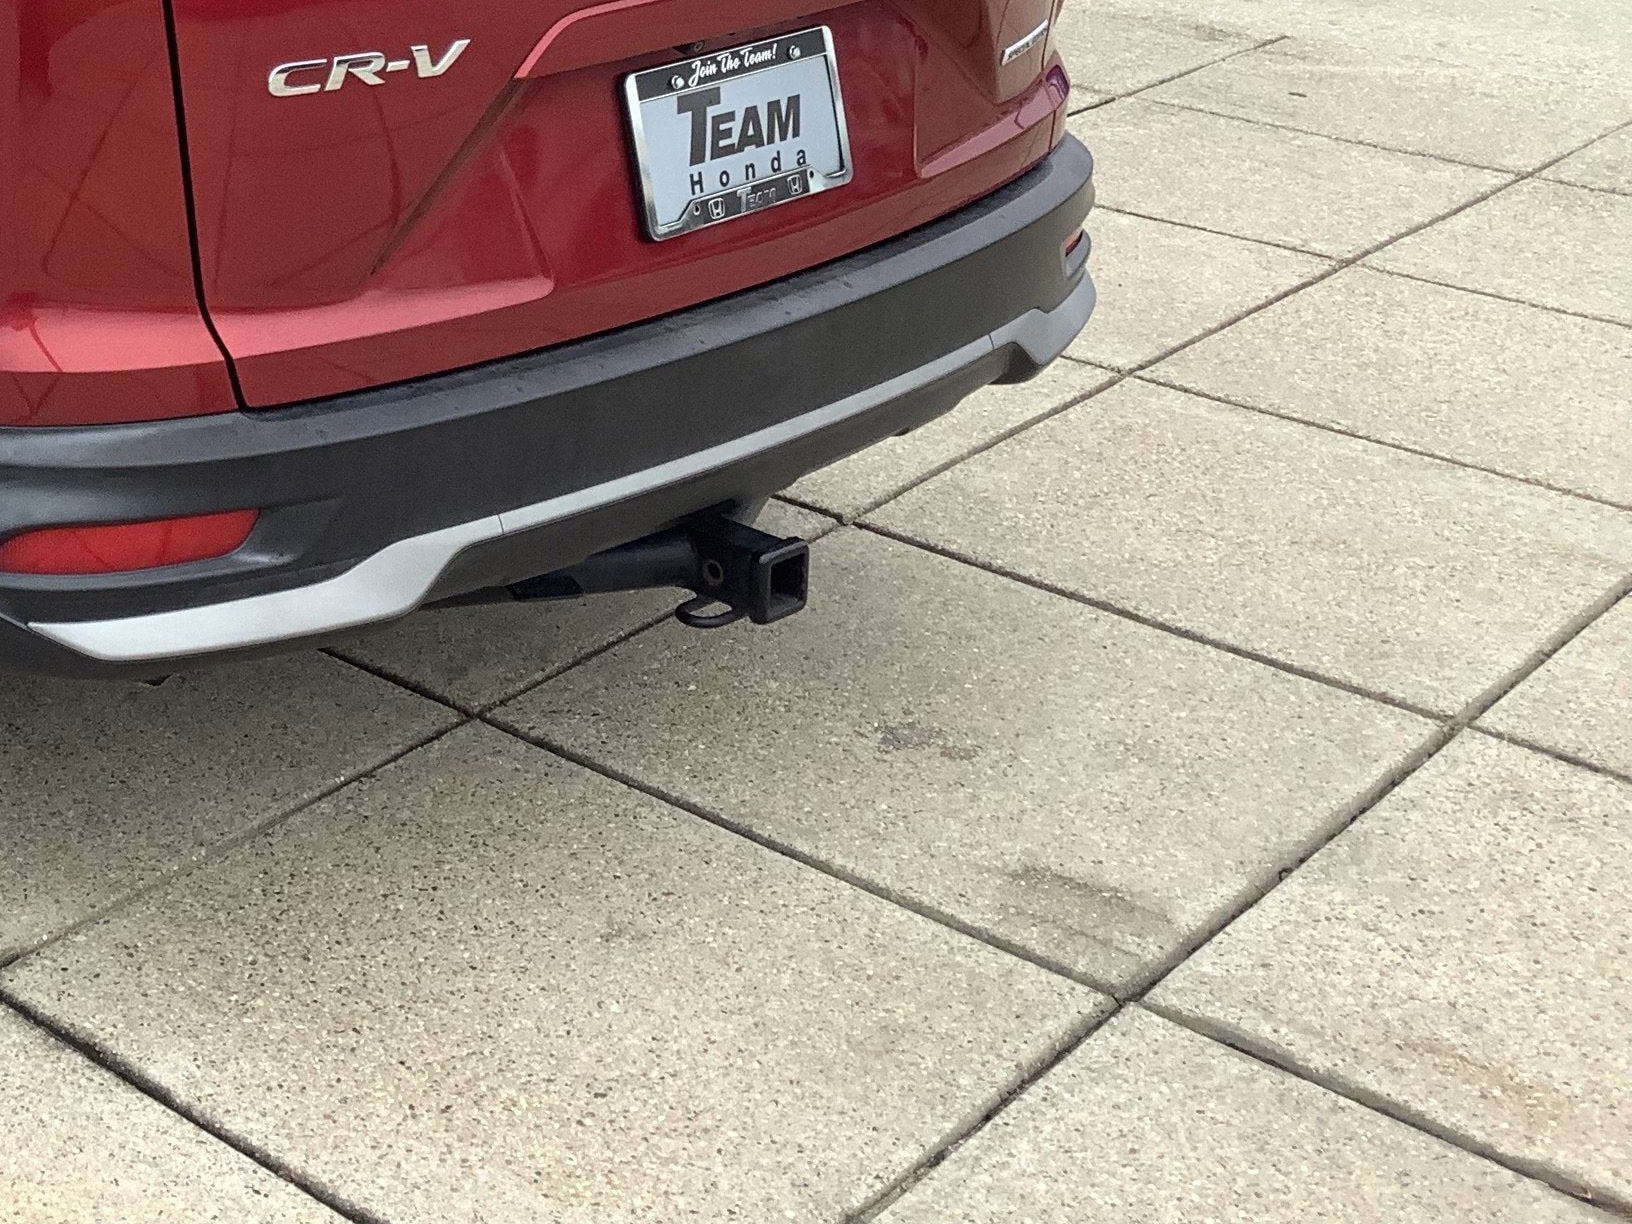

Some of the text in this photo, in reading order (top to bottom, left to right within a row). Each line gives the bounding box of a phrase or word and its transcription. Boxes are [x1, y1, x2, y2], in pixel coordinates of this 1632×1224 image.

[267, 38, 471, 97] CR-V
[688, 42, 778, 87] Join The Team!
[676, 86, 801, 167] TEAM
[689, 148, 807, 196] Honda
